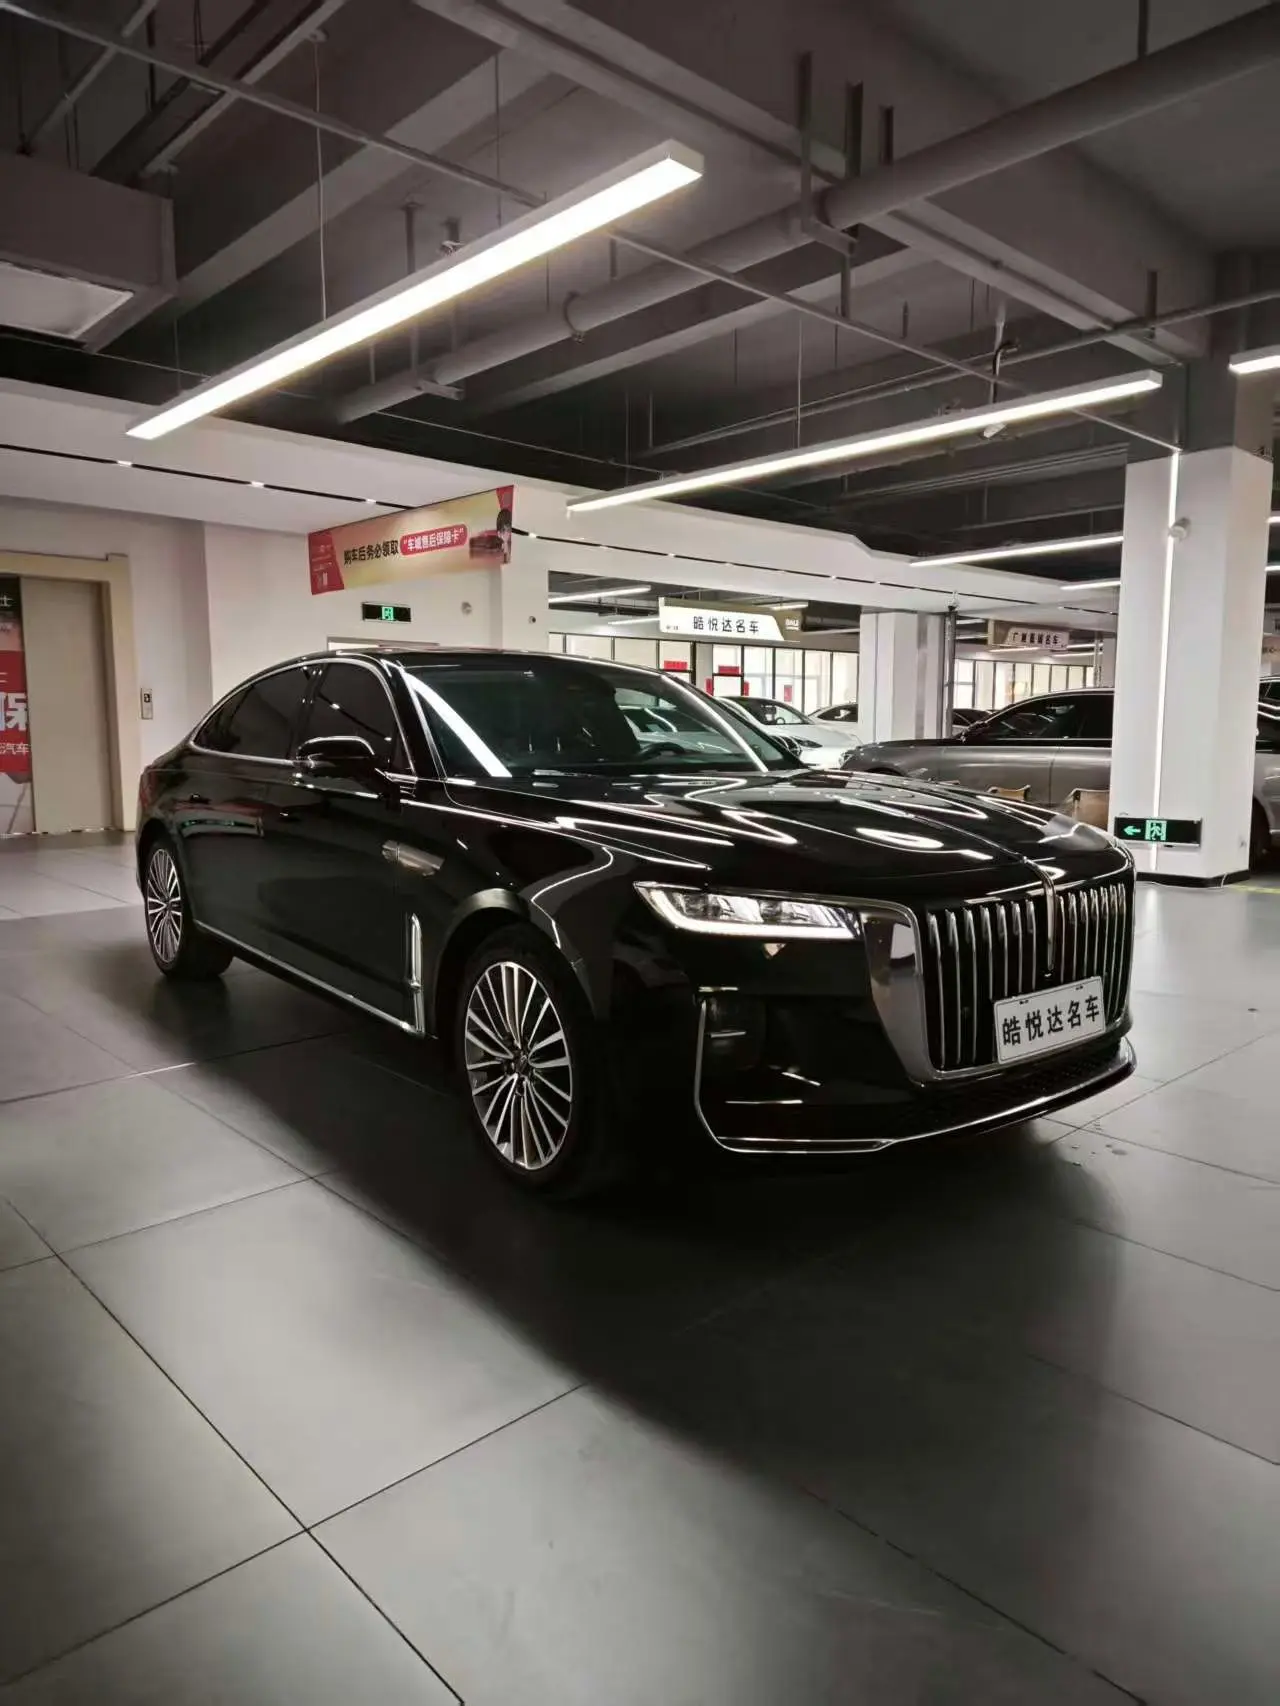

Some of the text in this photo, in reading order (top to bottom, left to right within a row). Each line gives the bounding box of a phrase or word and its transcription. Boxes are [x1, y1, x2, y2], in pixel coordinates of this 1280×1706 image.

[344, 540, 399, 564] 购车后务必领取
[693, 616, 759, 634] 皓悦达名车
[1002, 995, 1100, 1046] 皓悦达名车
